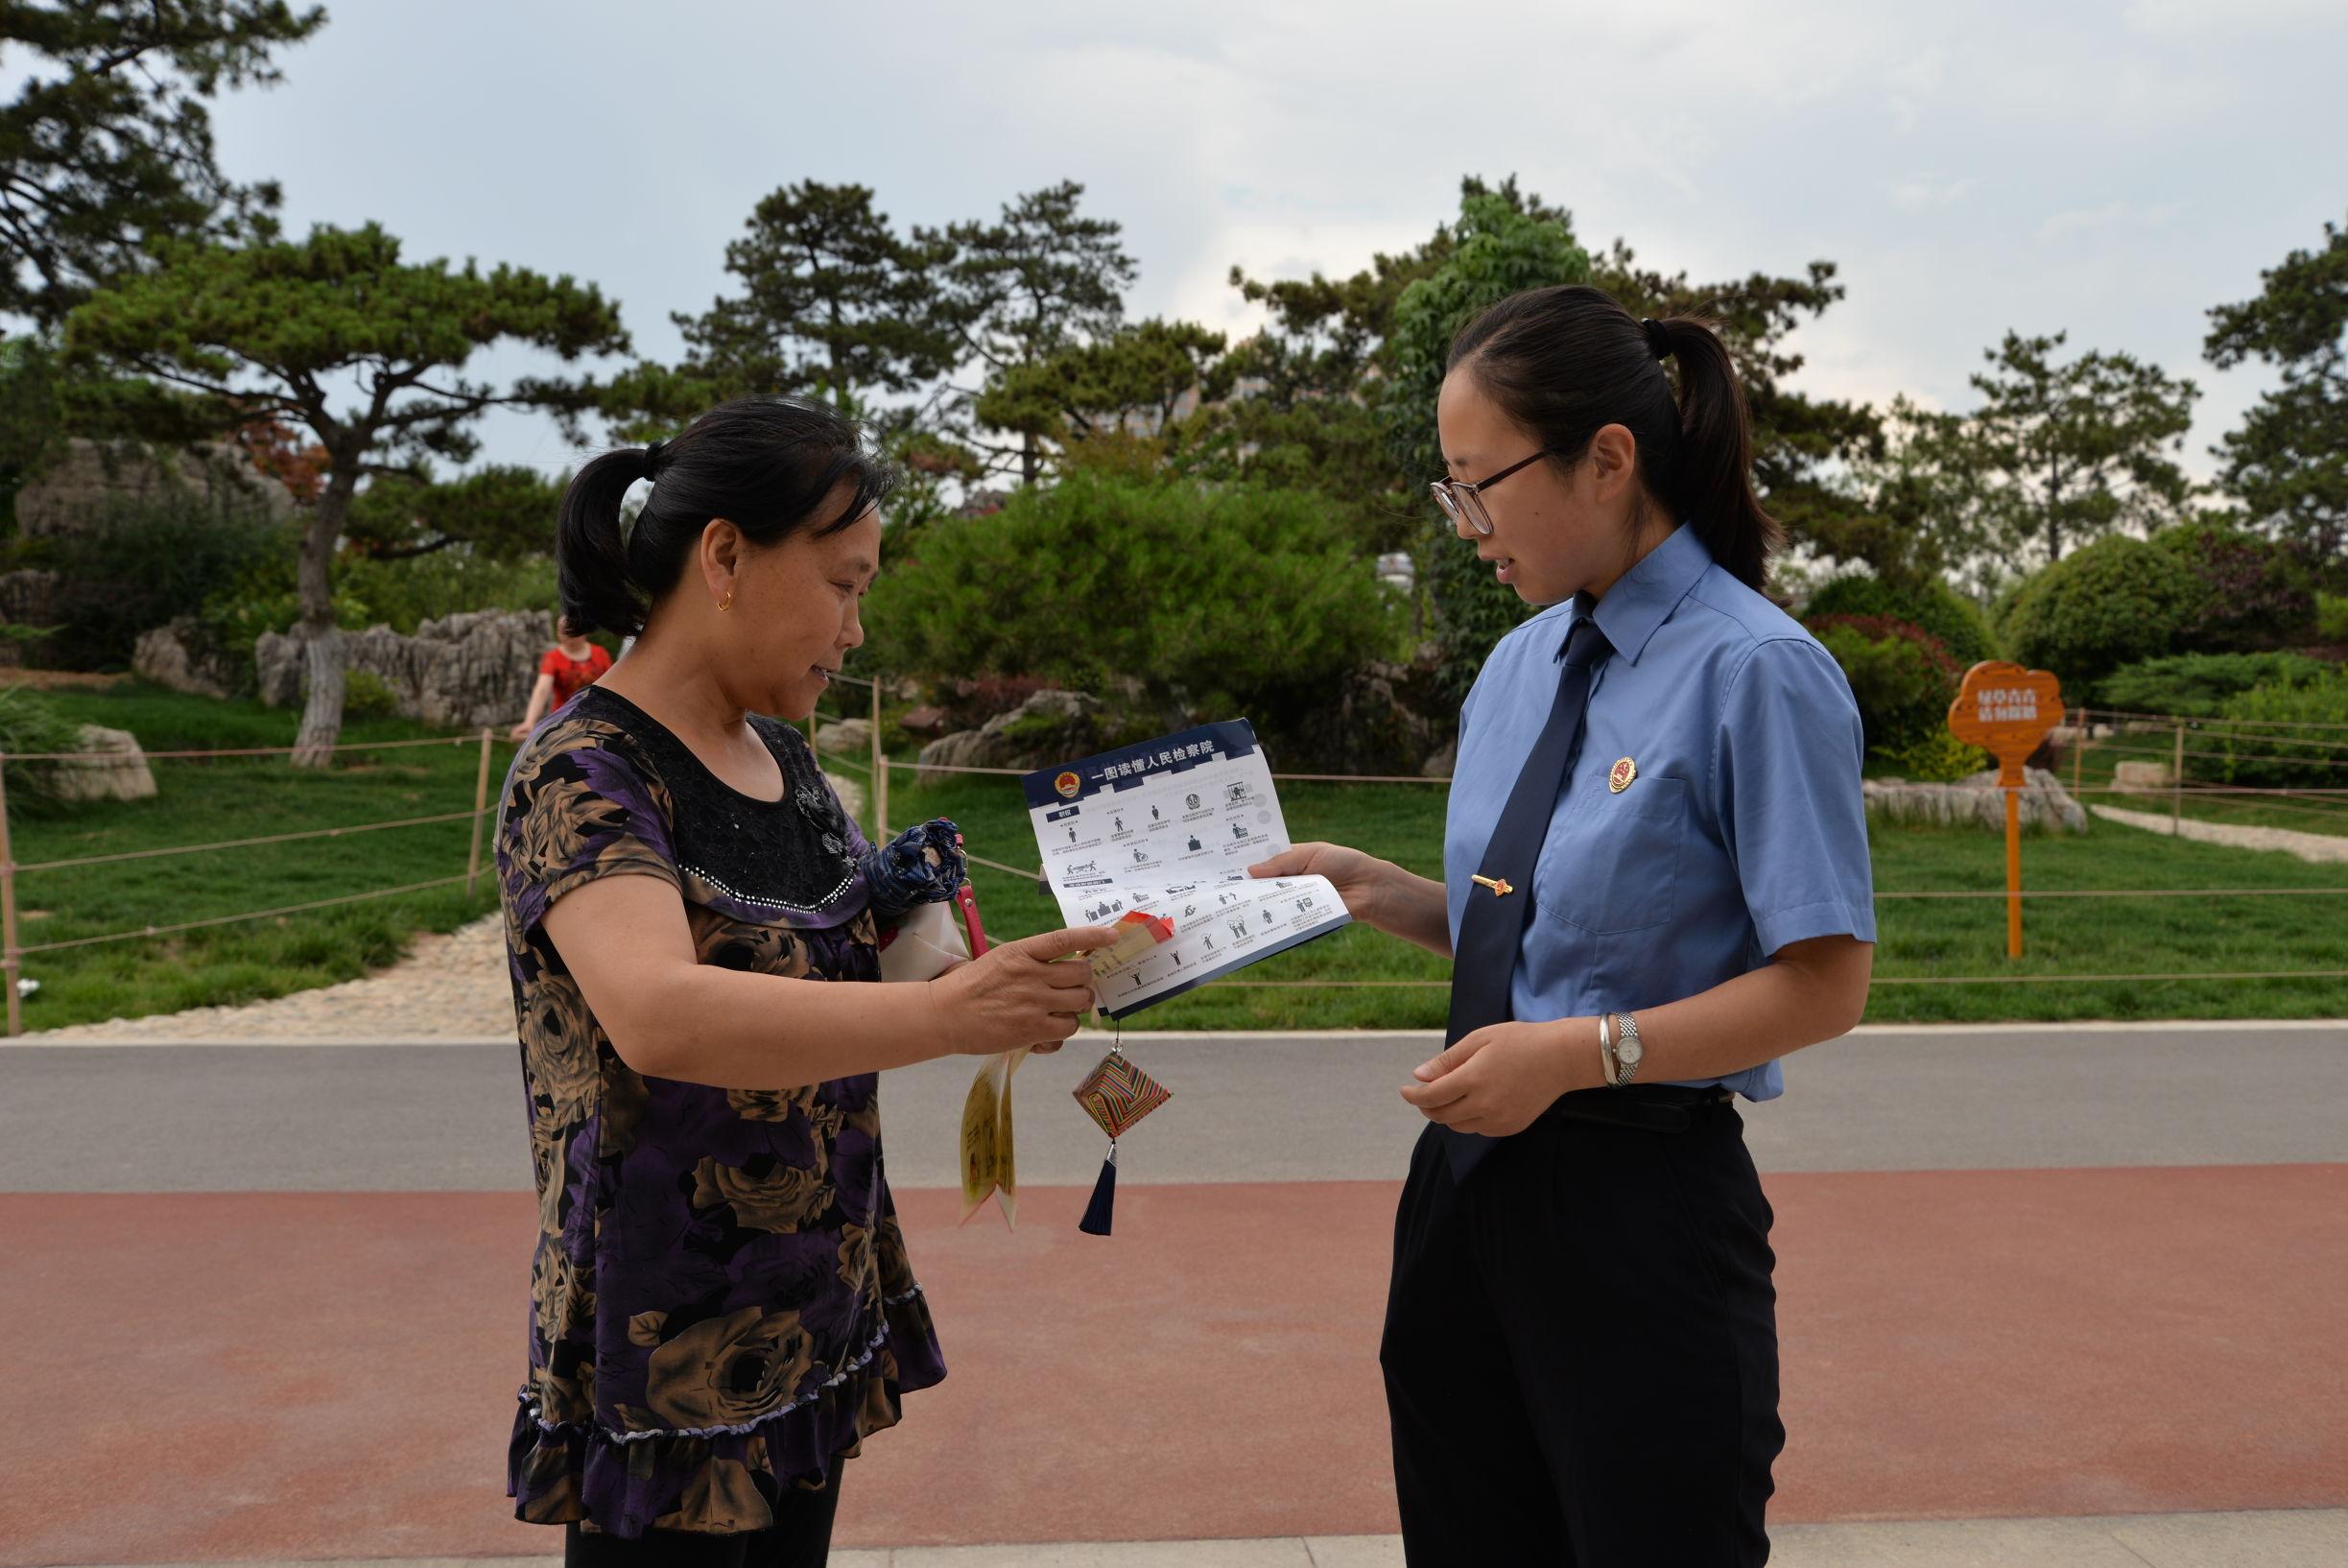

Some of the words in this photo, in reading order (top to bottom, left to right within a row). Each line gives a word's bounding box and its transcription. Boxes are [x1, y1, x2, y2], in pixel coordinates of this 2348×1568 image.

[1091, 740, 1215, 781] 一图读懂人民检察院
